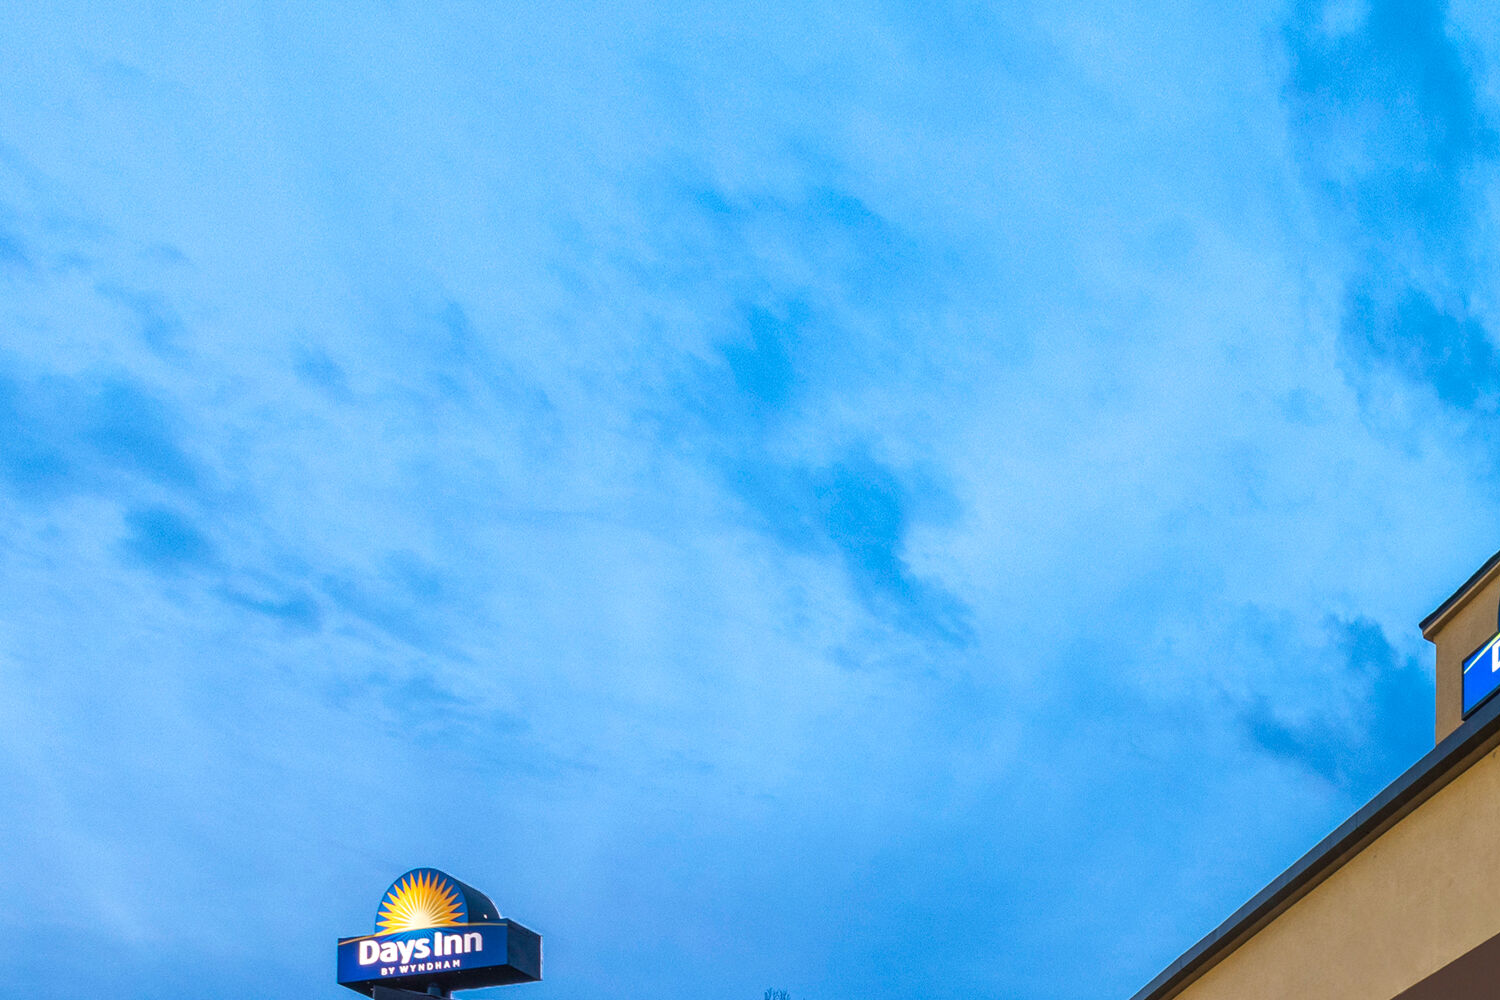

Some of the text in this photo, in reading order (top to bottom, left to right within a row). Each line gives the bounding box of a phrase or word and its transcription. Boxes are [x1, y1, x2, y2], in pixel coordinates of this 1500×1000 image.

[359, 932, 483, 964] Days Inn
[381, 959, 461, 976] BY WYNDHAM
